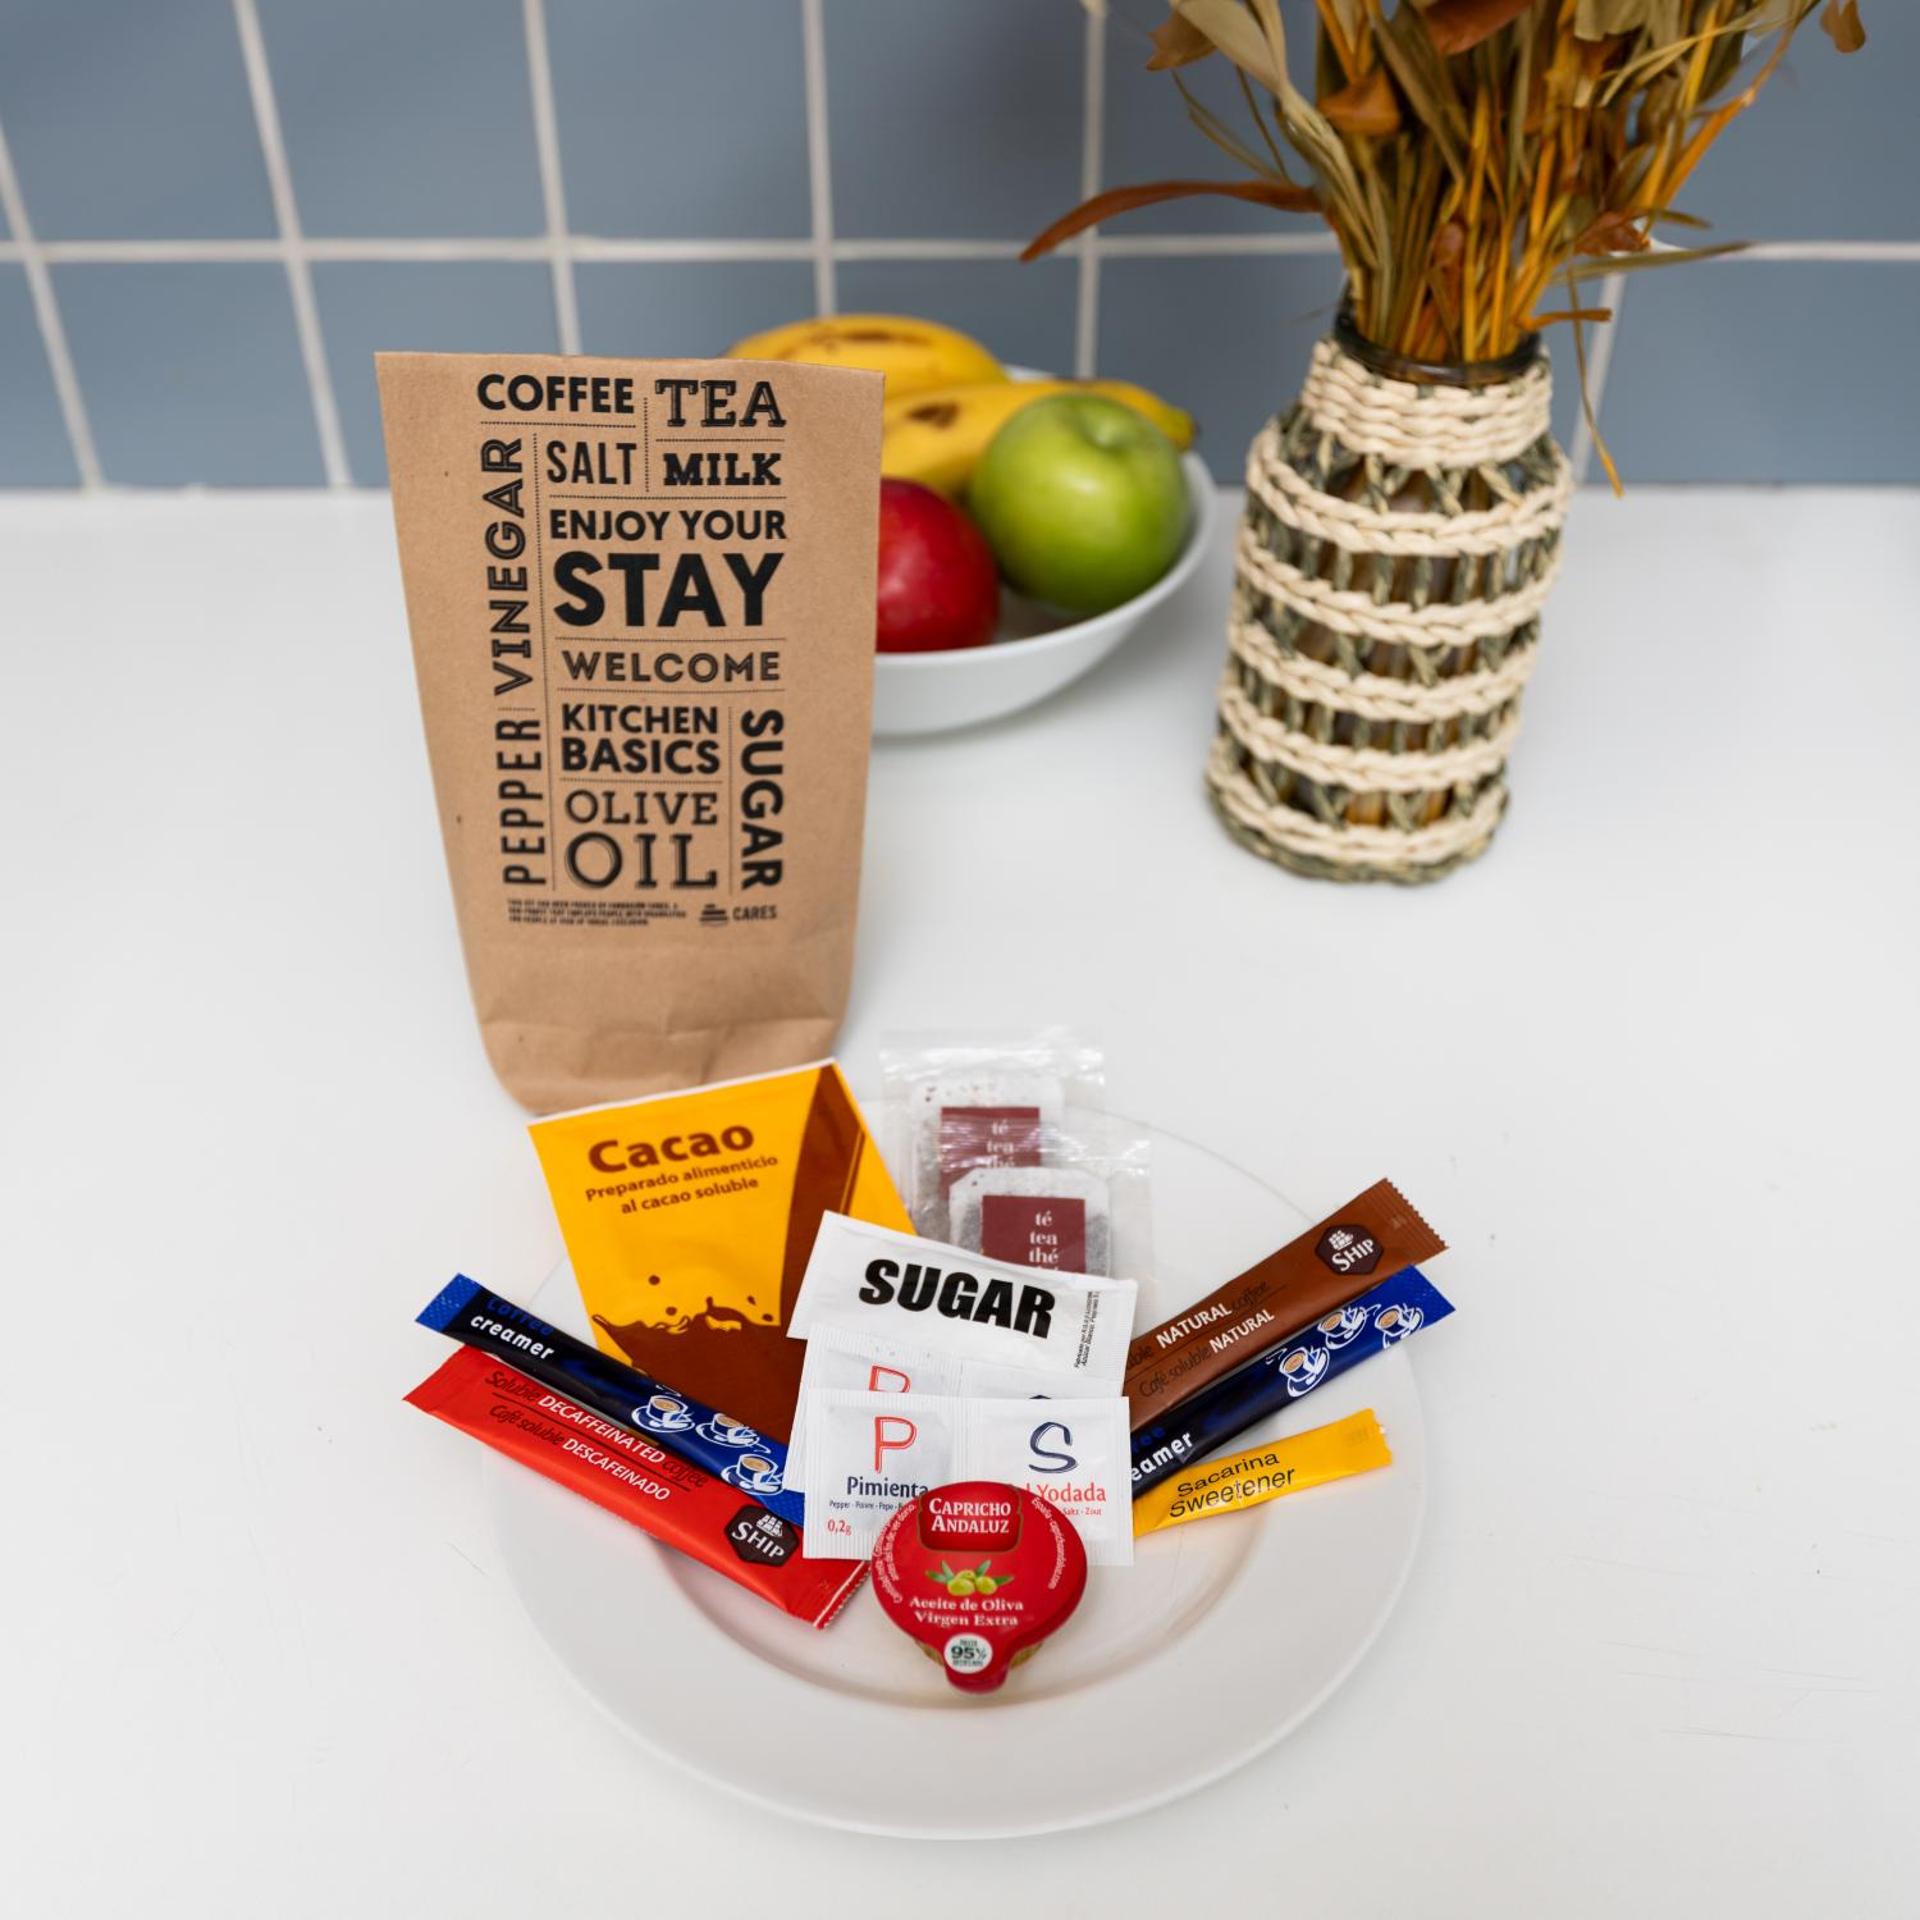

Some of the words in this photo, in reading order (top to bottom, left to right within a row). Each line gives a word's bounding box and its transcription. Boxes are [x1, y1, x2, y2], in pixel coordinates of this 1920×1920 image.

[477, 374, 634, 414] COFFEE
[655, 379, 786, 428] TEA
[546, 440, 637, 485] SALT
[663, 453, 781, 486] MILK
[550, 509, 670, 541] ENJOY
[679, 510, 787, 540] YOUR
[480, 438, 534, 696] VINEGAR
[553, 551, 784, 628] STAY
[561, 650, 780, 683] WELCOME
[562, 703, 718, 734] KITCHEN
[562, 736, 720, 775] BASICS
[495, 719, 546, 885] PEPPER
[564, 789, 718, 825] OLIVE
[740, 709, 784, 890] SUGAR
[564, 831, 718, 890] OIL
[732, 904, 778, 921] CARES
[588, 1125, 755, 1173] Cacao
[585, 1172, 680, 1202] Preparado
[682, 1154, 779, 1182] alimenticio
[620, 1200, 638, 1215] al
[641, 1191, 692, 1211] cacao
[695, 1177, 759, 1199] soluble
[1029, 1229, 1058, 1245] tea
[1034, 1210, 1053, 1227] té
[1028, 1246, 1060, 1265] thé
[1331, 1237, 1375, 1273] SHIP
[858, 1258, 1056, 1339] SUGAR
[469, 1314, 556, 1360] creamer
[1155, 1301, 1233, 1350] NATURAL
[1207, 1307, 1276, 1354] NATURAL
[484, 1370, 541, 1402] Soluble
[537, 1394, 666, 1465] DECAFFEINATED
[488, 1403, 519, 1425] Café
[517, 1415, 567, 1447] soluble
[561, 1437, 672, 1501] DESCAFEINADO
[873, 1415, 918, 1475] P
[1028, 1420, 1080, 1475] S
[1130, 1432, 1193, 1482] eamer
[846, 1475, 929, 1499] Pimienta
[1037, 1481, 1107, 1502] Yodada
[1168, 1467, 1297, 1519] Sweetener
[1176, 1451, 1281, 1498] Sacarina
[928, 1497, 1012, 1517] CAPRICHO
[931, 1515, 1010, 1535] ANDALUZ
[730, 1521, 786, 1558] SHIP
[827, 1518, 852, 1537] 0,2g
[908, 1596, 958, 1612] Aceite
[960, 1598, 978, 1611] de
[981, 1597, 1024, 1612] Oliva
[914, 1610, 970, 1628] Virgen
[973, 1612, 1019, 1627] Extra
